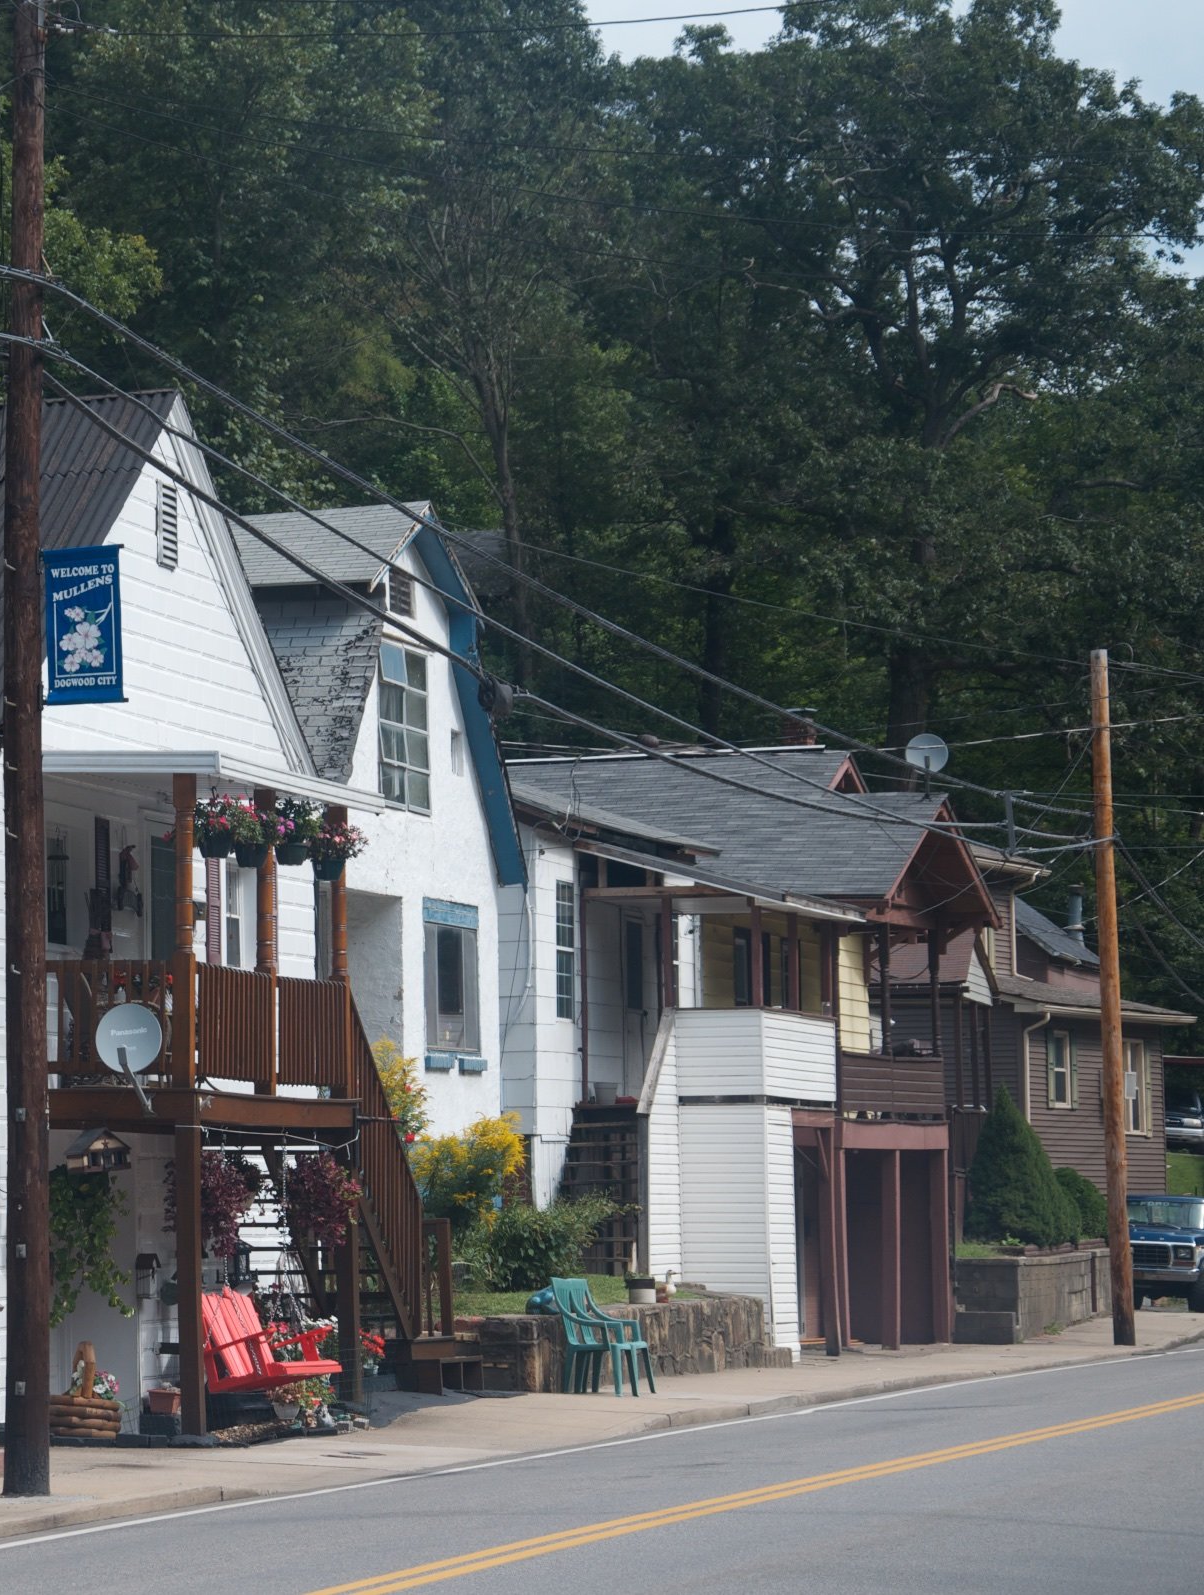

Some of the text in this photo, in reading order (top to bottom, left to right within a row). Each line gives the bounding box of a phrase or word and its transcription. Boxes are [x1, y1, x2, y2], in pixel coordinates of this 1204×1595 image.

[51, 563, 115, 578] WELCOME TO
[52, 574, 113, 602] MULLENS
[54, 676, 117, 688] DOGWOOD CITY
[110, 1026, 148, 1037] Panasonic
